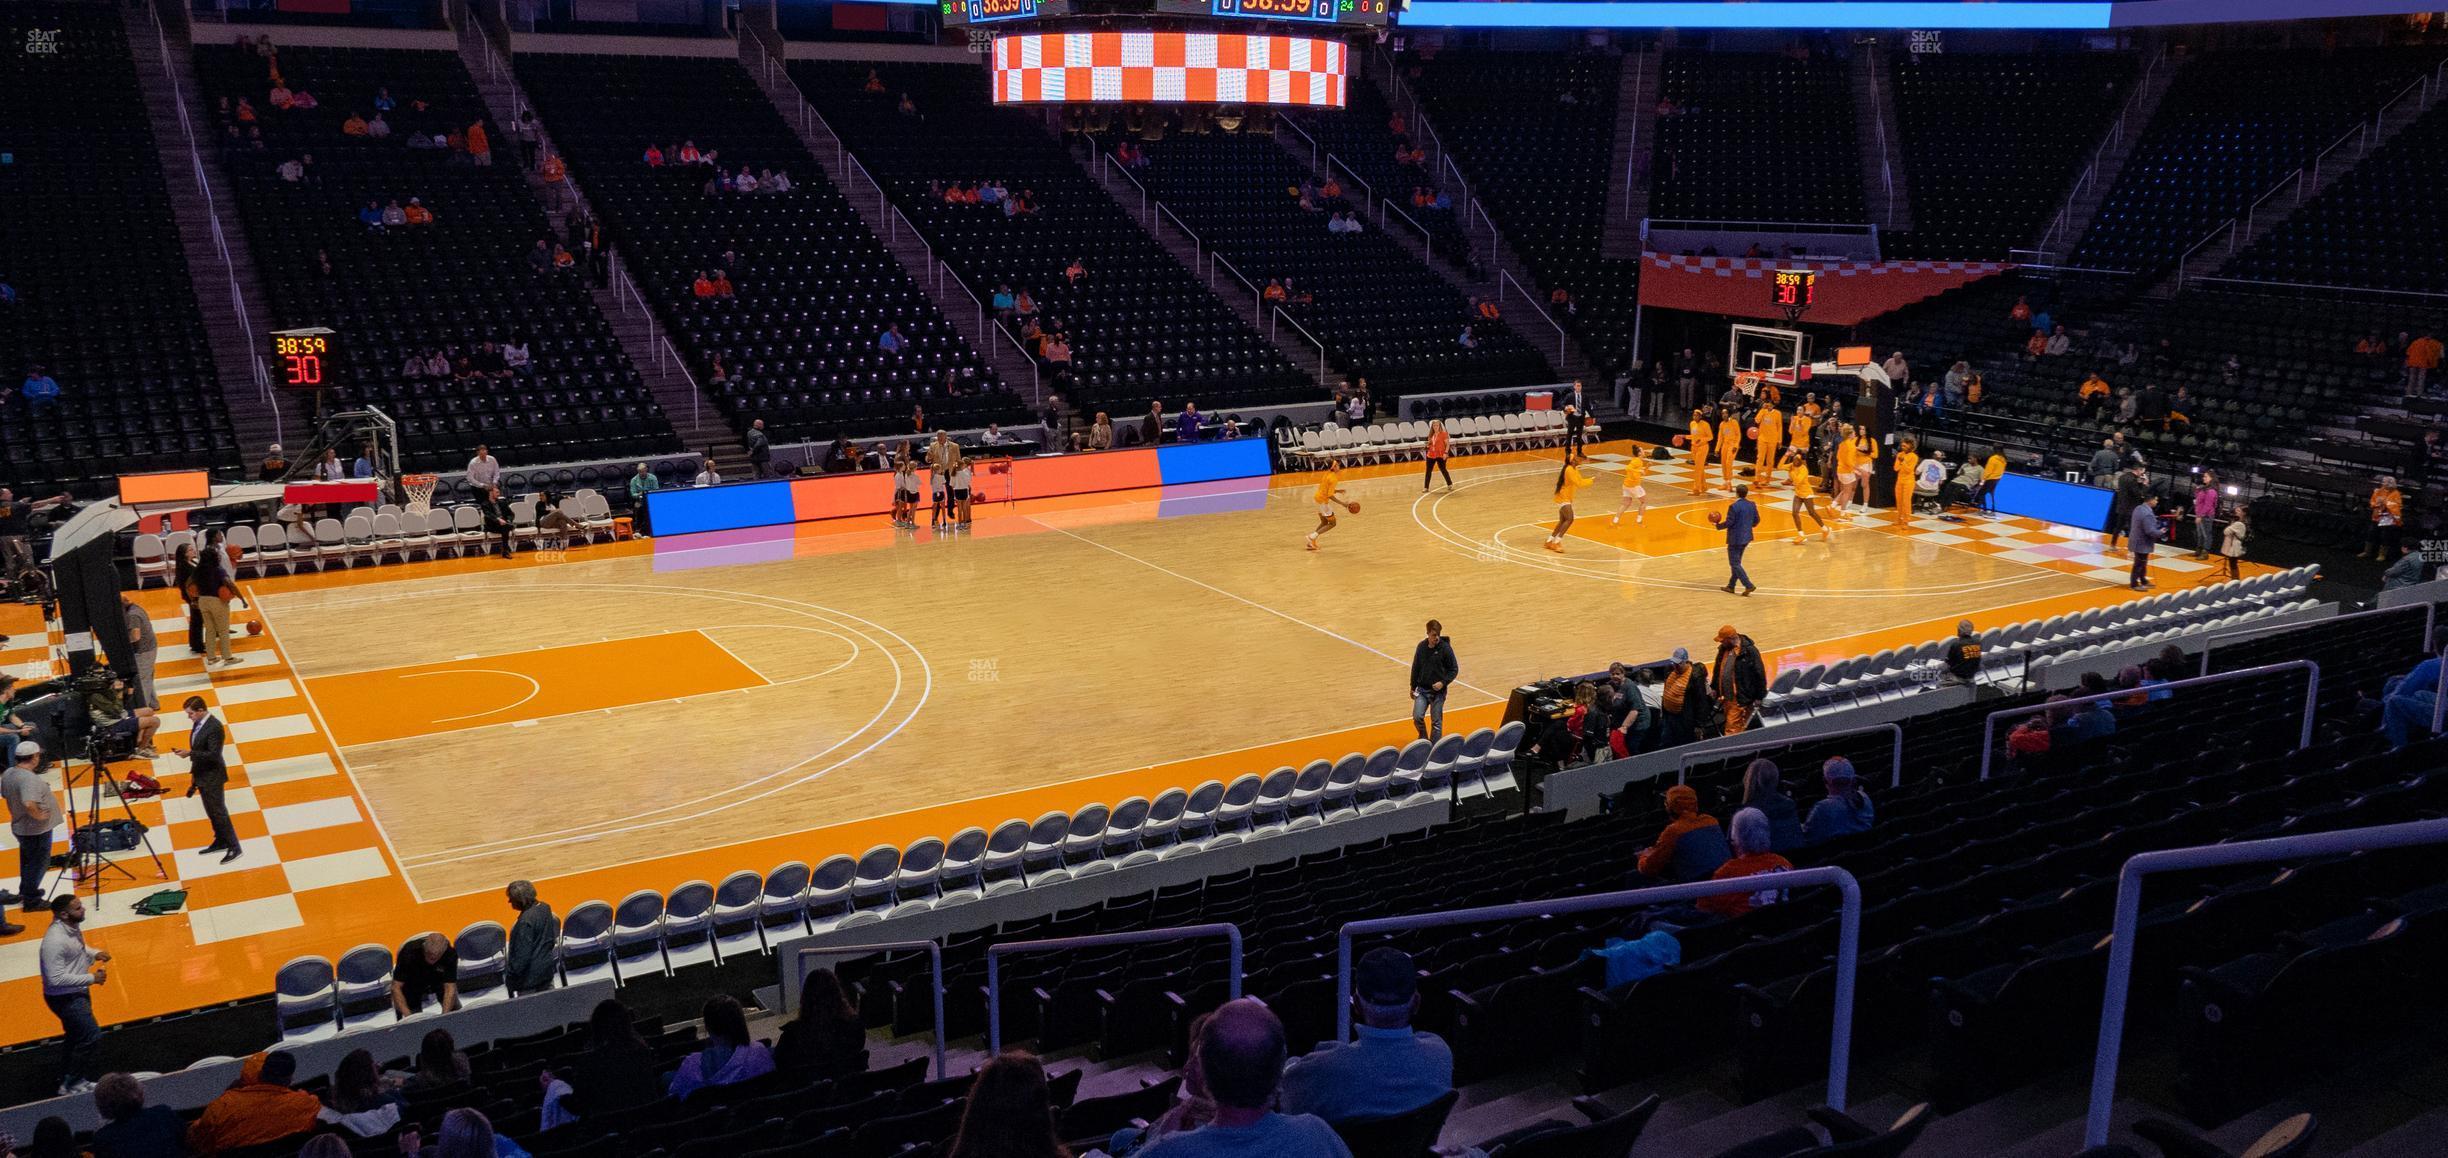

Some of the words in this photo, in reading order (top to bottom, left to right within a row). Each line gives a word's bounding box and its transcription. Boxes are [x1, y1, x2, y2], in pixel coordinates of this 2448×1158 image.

[973, 4, 979, 16] 0
[1320, 2, 1328, 15] 0
[1340, 0, 1354, 12] 24
[1361, 0, 1369, 12] 0
[1375, 2, 1383, 13] 0
[1776, 273, 1800, 285] 38:59
[1778, 285, 1796, 304] 30
[276, 338, 325, 354] 38:59
[286, 355, 321, 384] 30
